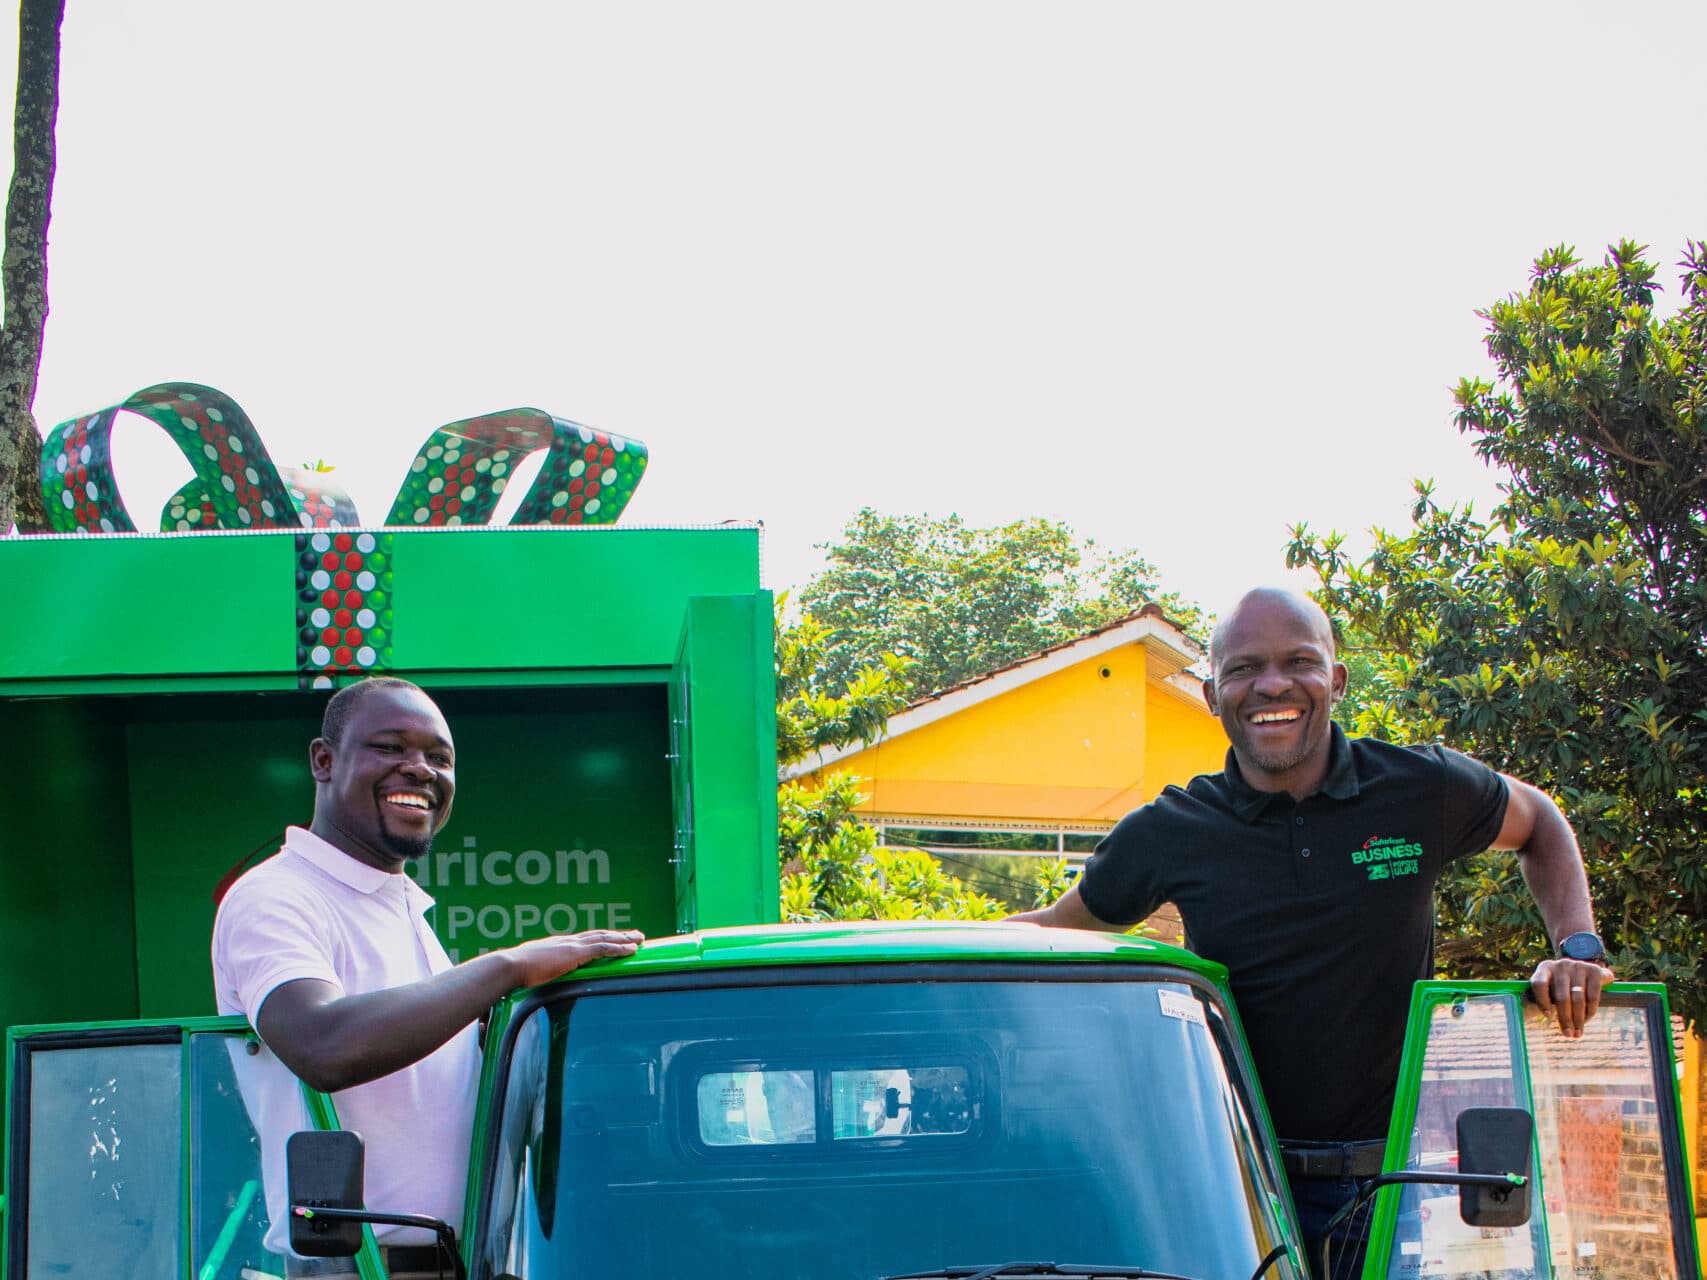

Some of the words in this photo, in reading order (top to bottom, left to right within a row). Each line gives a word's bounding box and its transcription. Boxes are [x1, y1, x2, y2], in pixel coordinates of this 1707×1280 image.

[404, 836, 611, 887] aricom
[1351, 843, 1423, 864] BUSINESS
[448, 902, 632, 939] POPOTE
